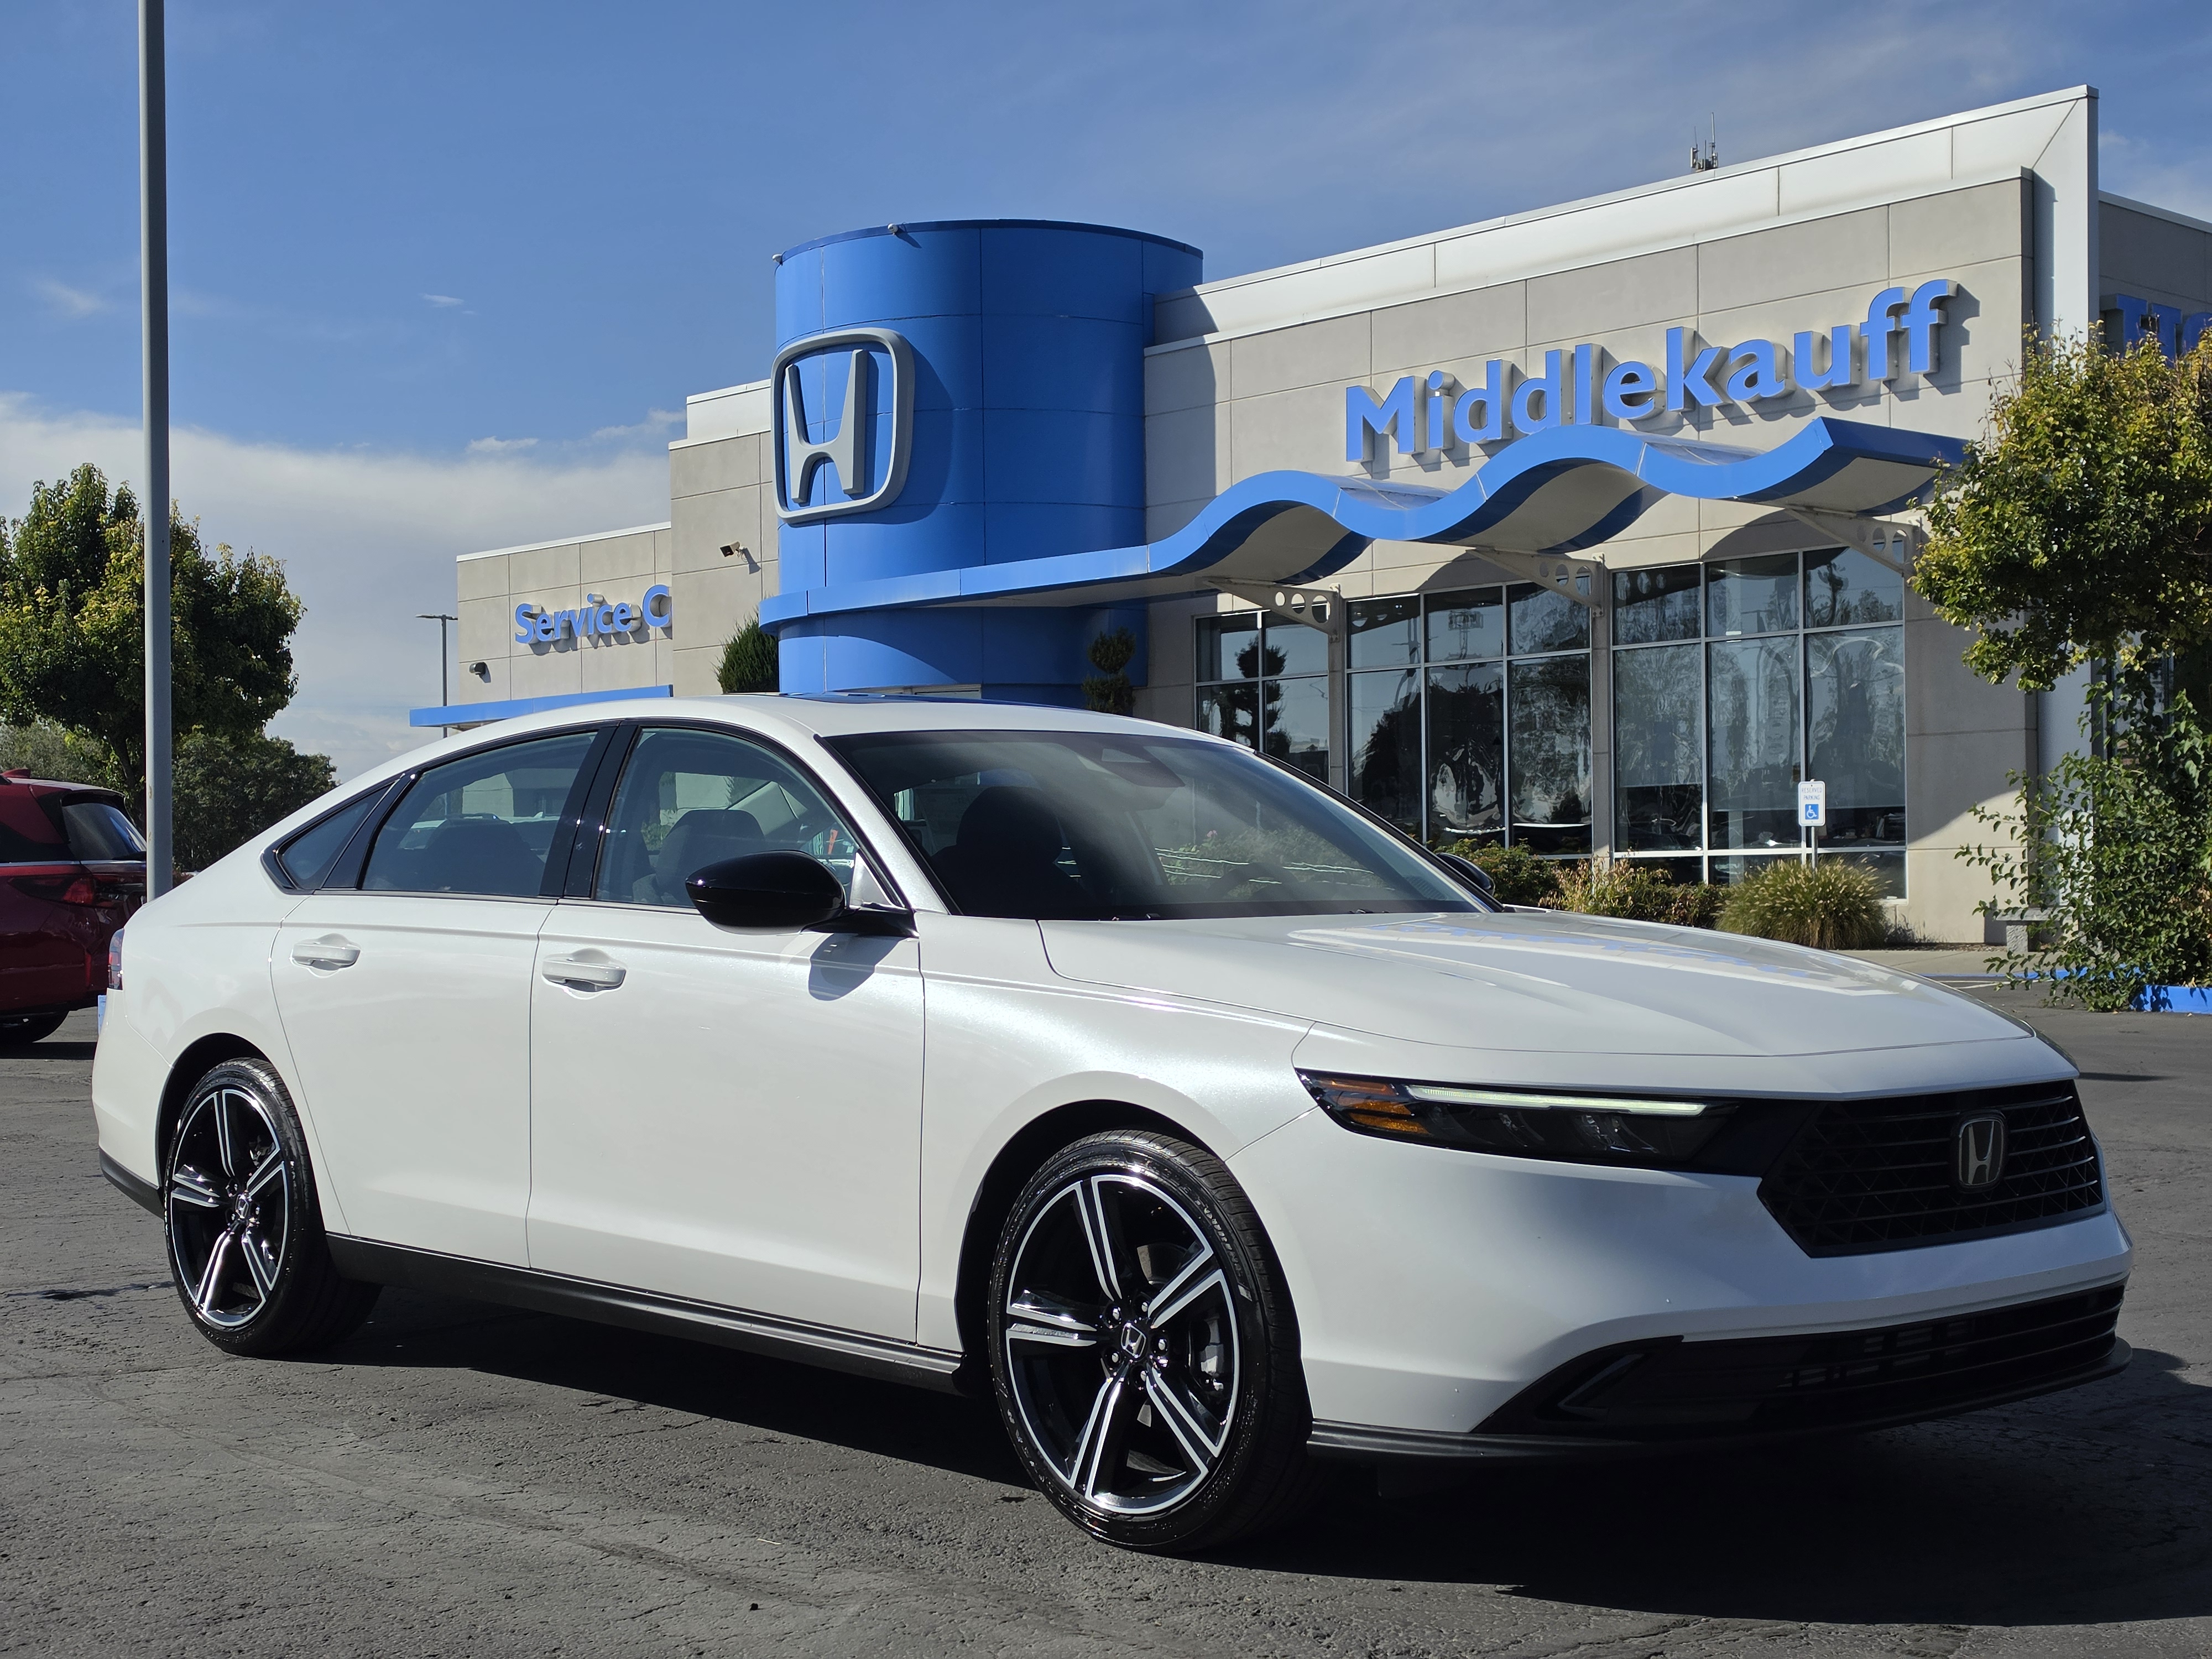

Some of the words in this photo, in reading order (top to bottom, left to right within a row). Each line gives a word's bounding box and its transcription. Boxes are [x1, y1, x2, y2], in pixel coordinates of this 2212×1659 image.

[1345, 279, 1958, 462] Middlekauff
[515, 593, 637, 644] Service
[642, 584, 672, 627] C
